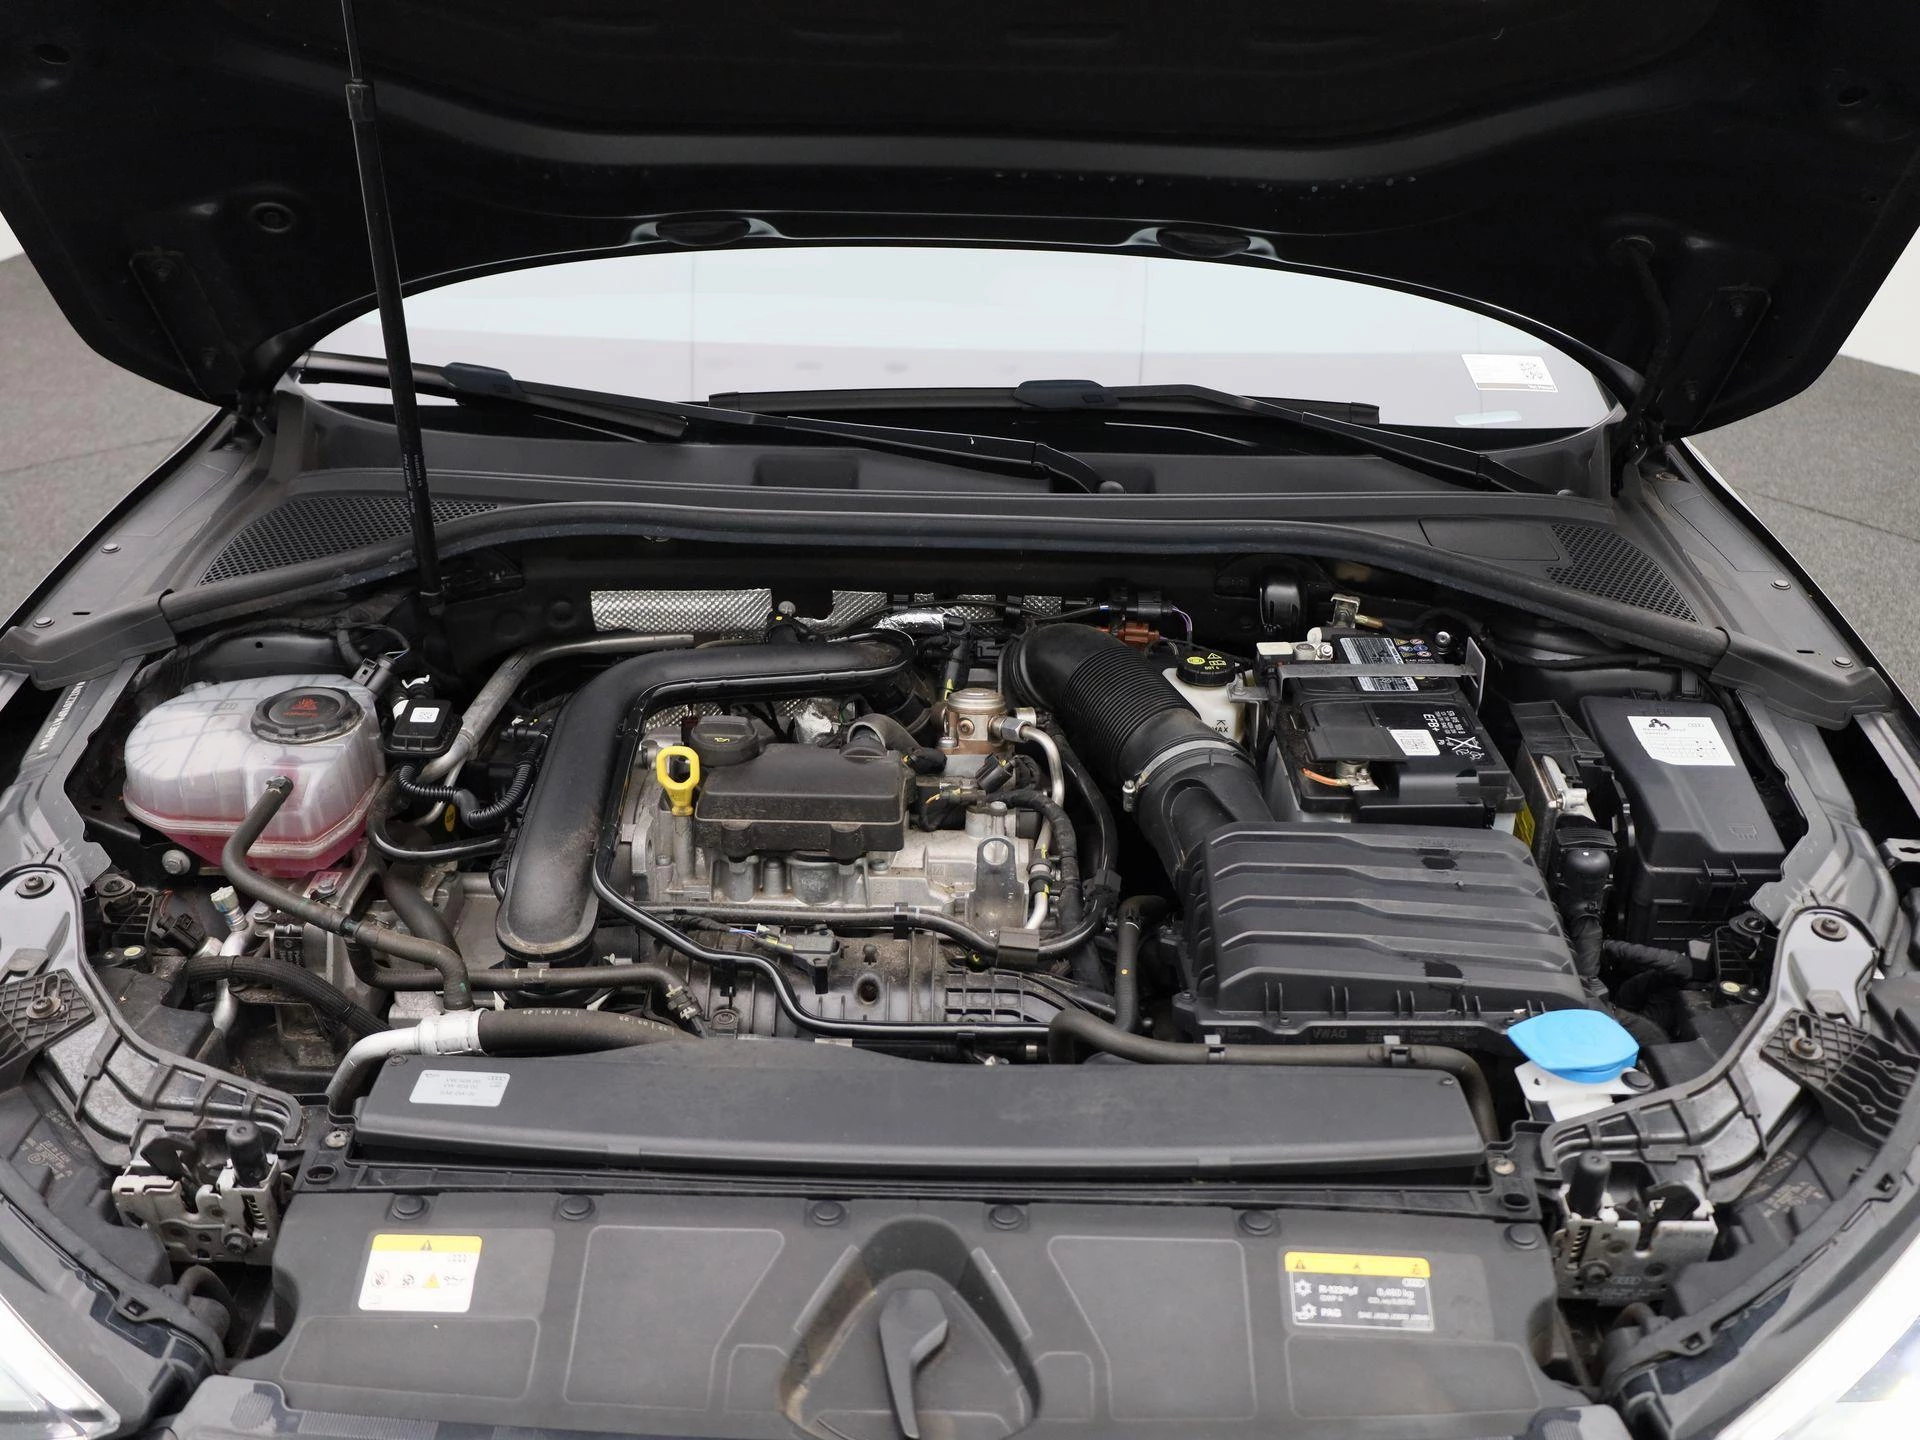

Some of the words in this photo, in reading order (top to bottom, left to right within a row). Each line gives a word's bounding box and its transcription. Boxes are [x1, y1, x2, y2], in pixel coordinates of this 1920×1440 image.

[1423, 713, 1440, 732] EFB+
[1313, 1028, 1348, 1039] VWAG
[1320, 1307, 1342, 1318] PAG
